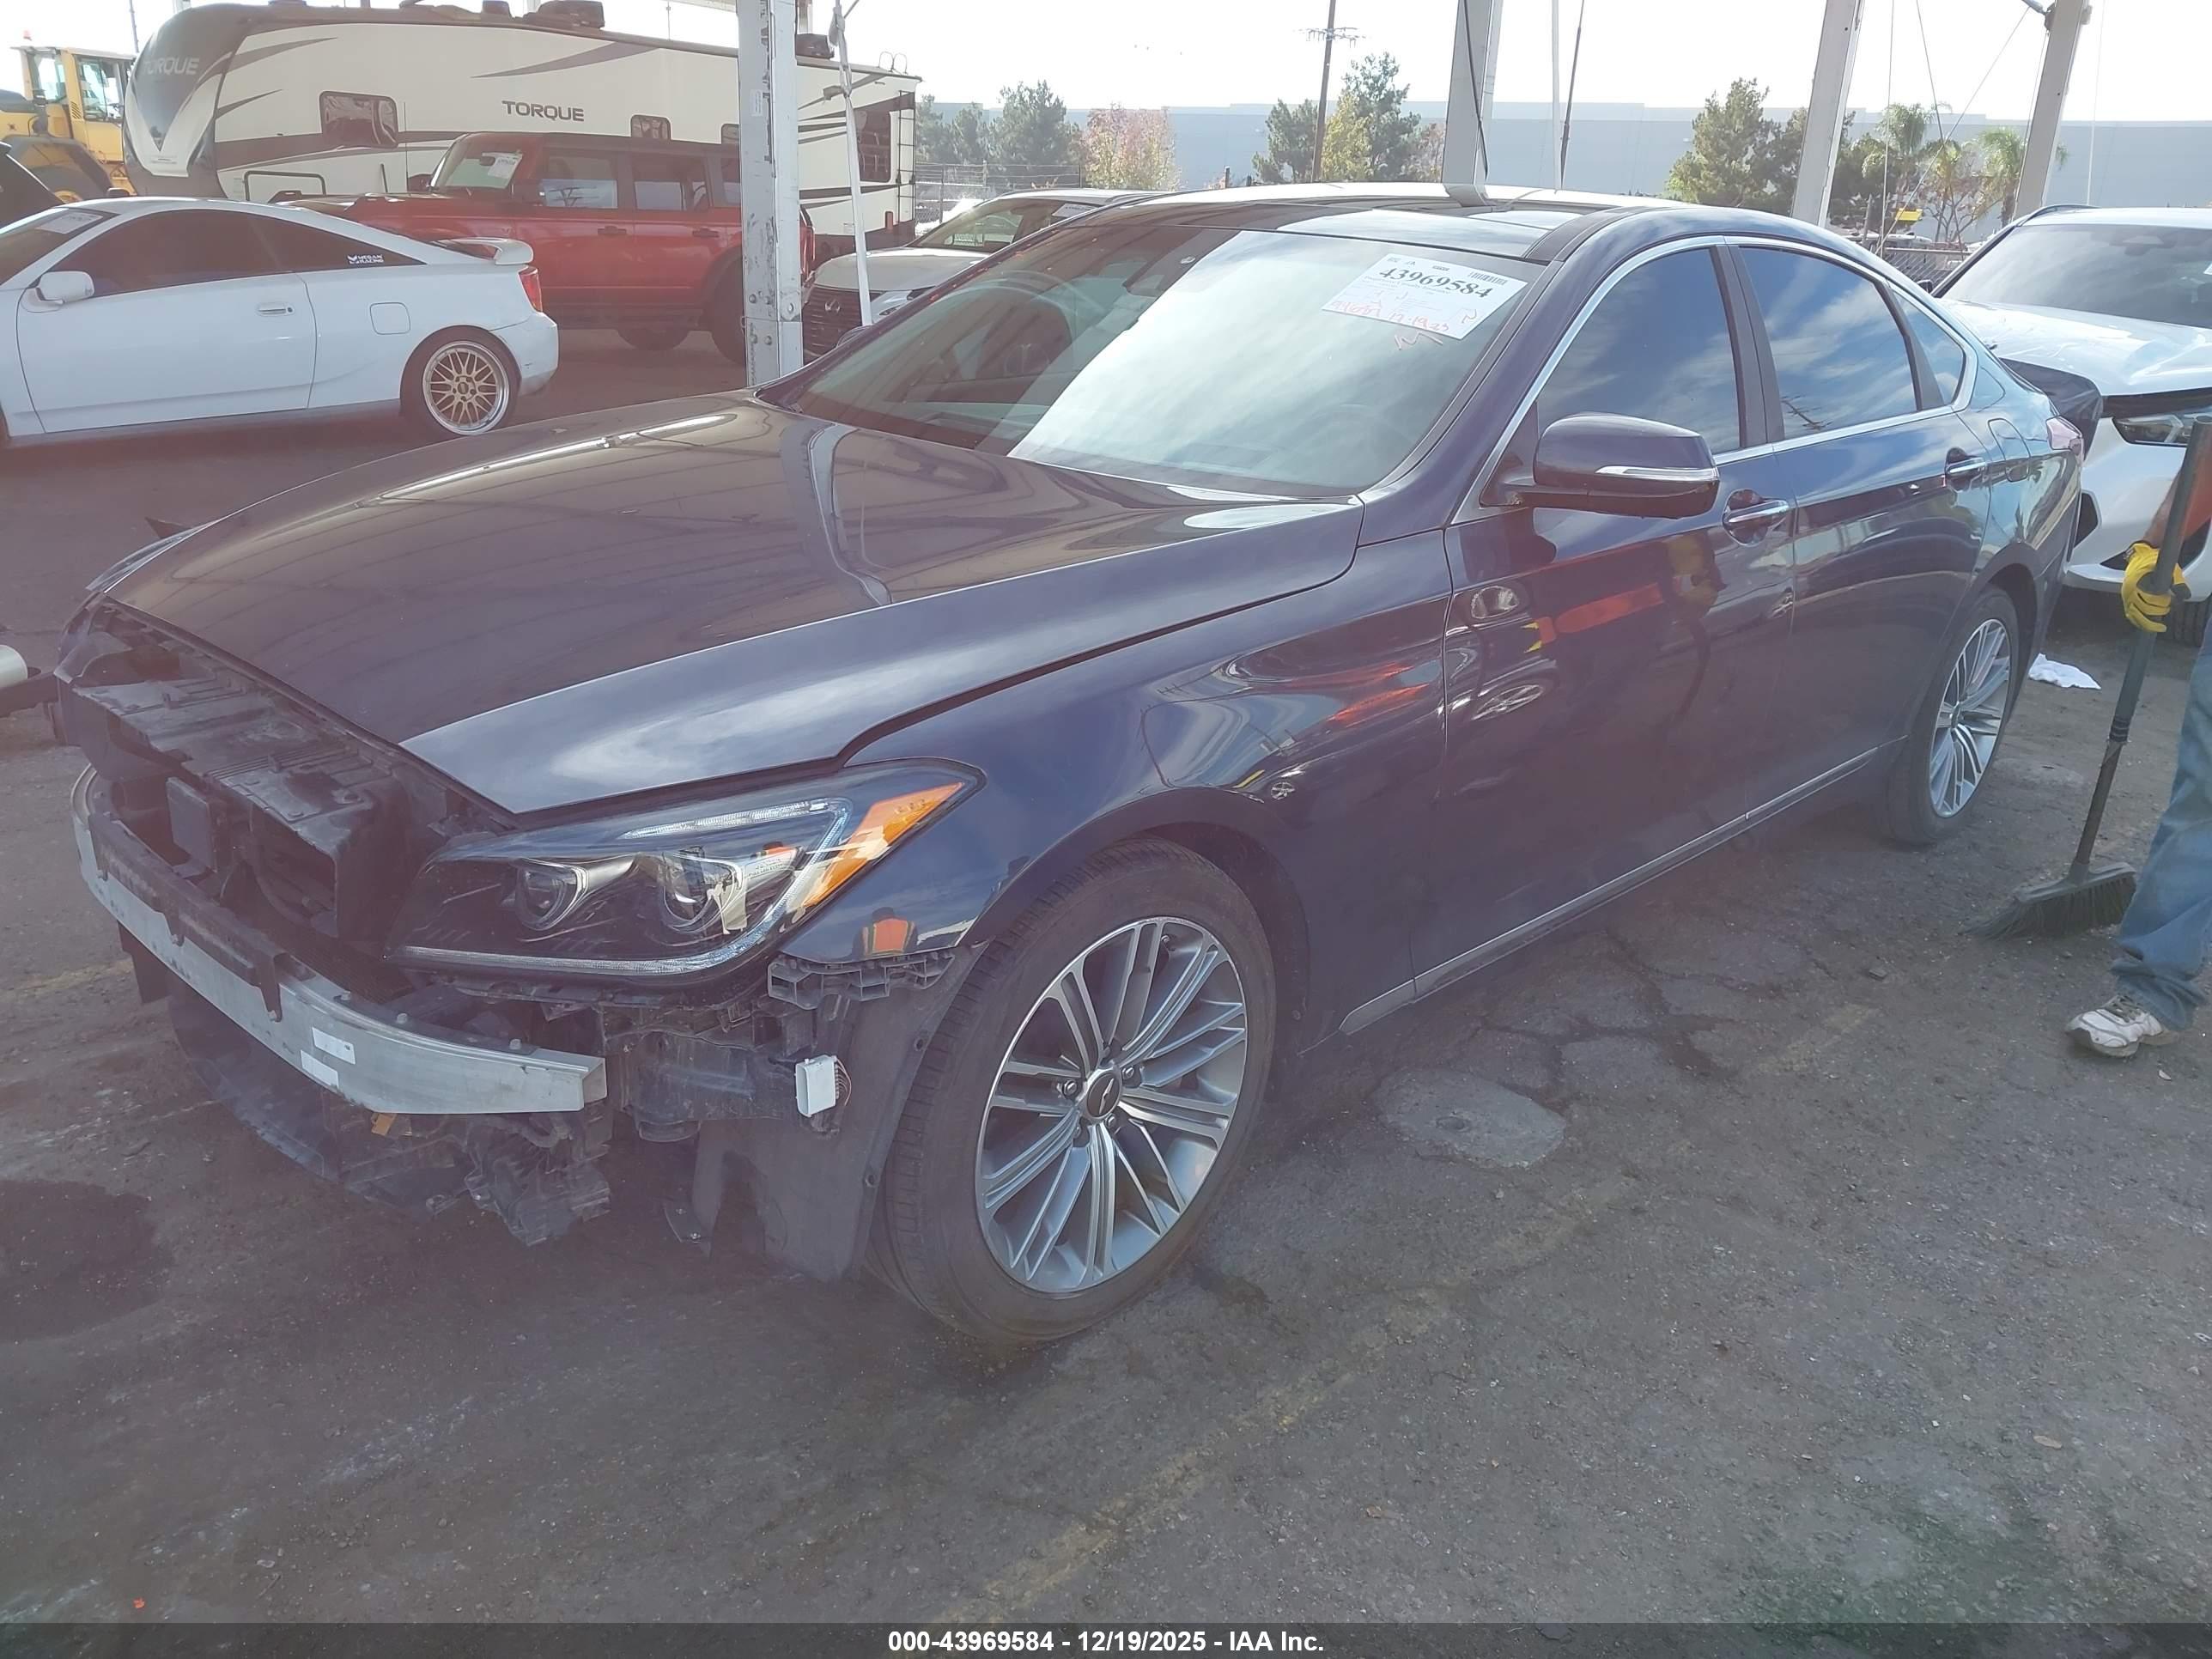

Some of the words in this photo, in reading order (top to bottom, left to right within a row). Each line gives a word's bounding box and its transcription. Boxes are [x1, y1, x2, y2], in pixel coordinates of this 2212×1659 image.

[143, 57, 200, 76] TORQUE
[501, 100, 585, 122] TORQUE
[1379, 268, 1494, 298] 43969584
